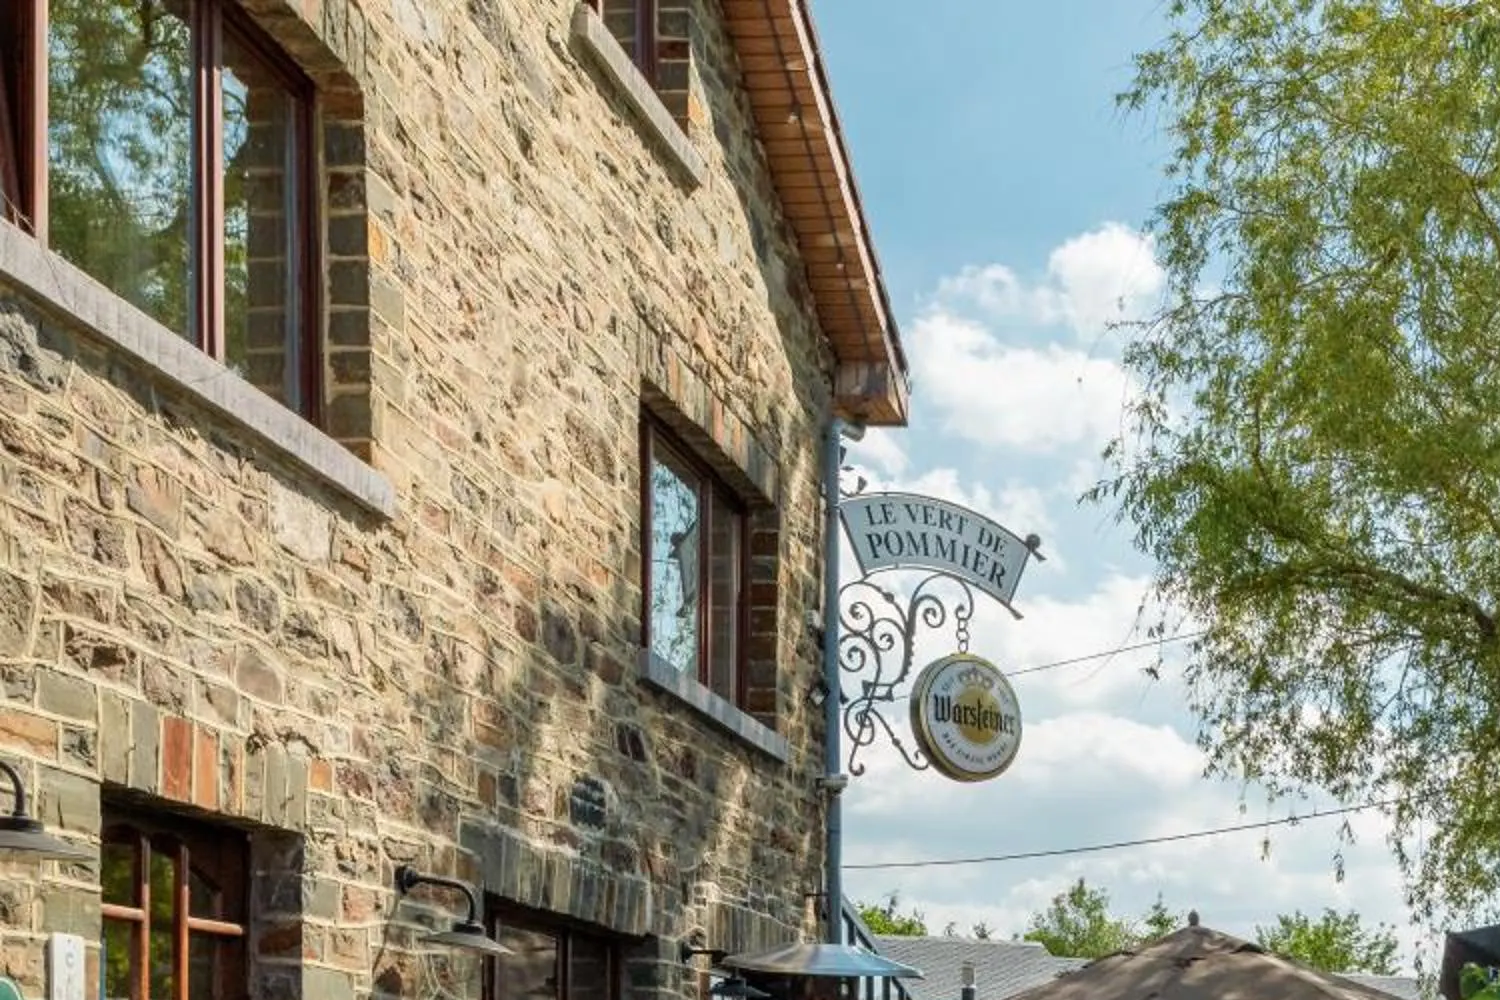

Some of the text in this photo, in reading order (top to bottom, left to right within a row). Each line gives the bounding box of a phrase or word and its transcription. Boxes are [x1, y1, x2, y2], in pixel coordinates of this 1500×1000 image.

[864, 502, 1008, 557] LE VERT DE
[866, 532, 1007, 589] POMMIER
[933, 692, 1015, 736] Warsteiner
